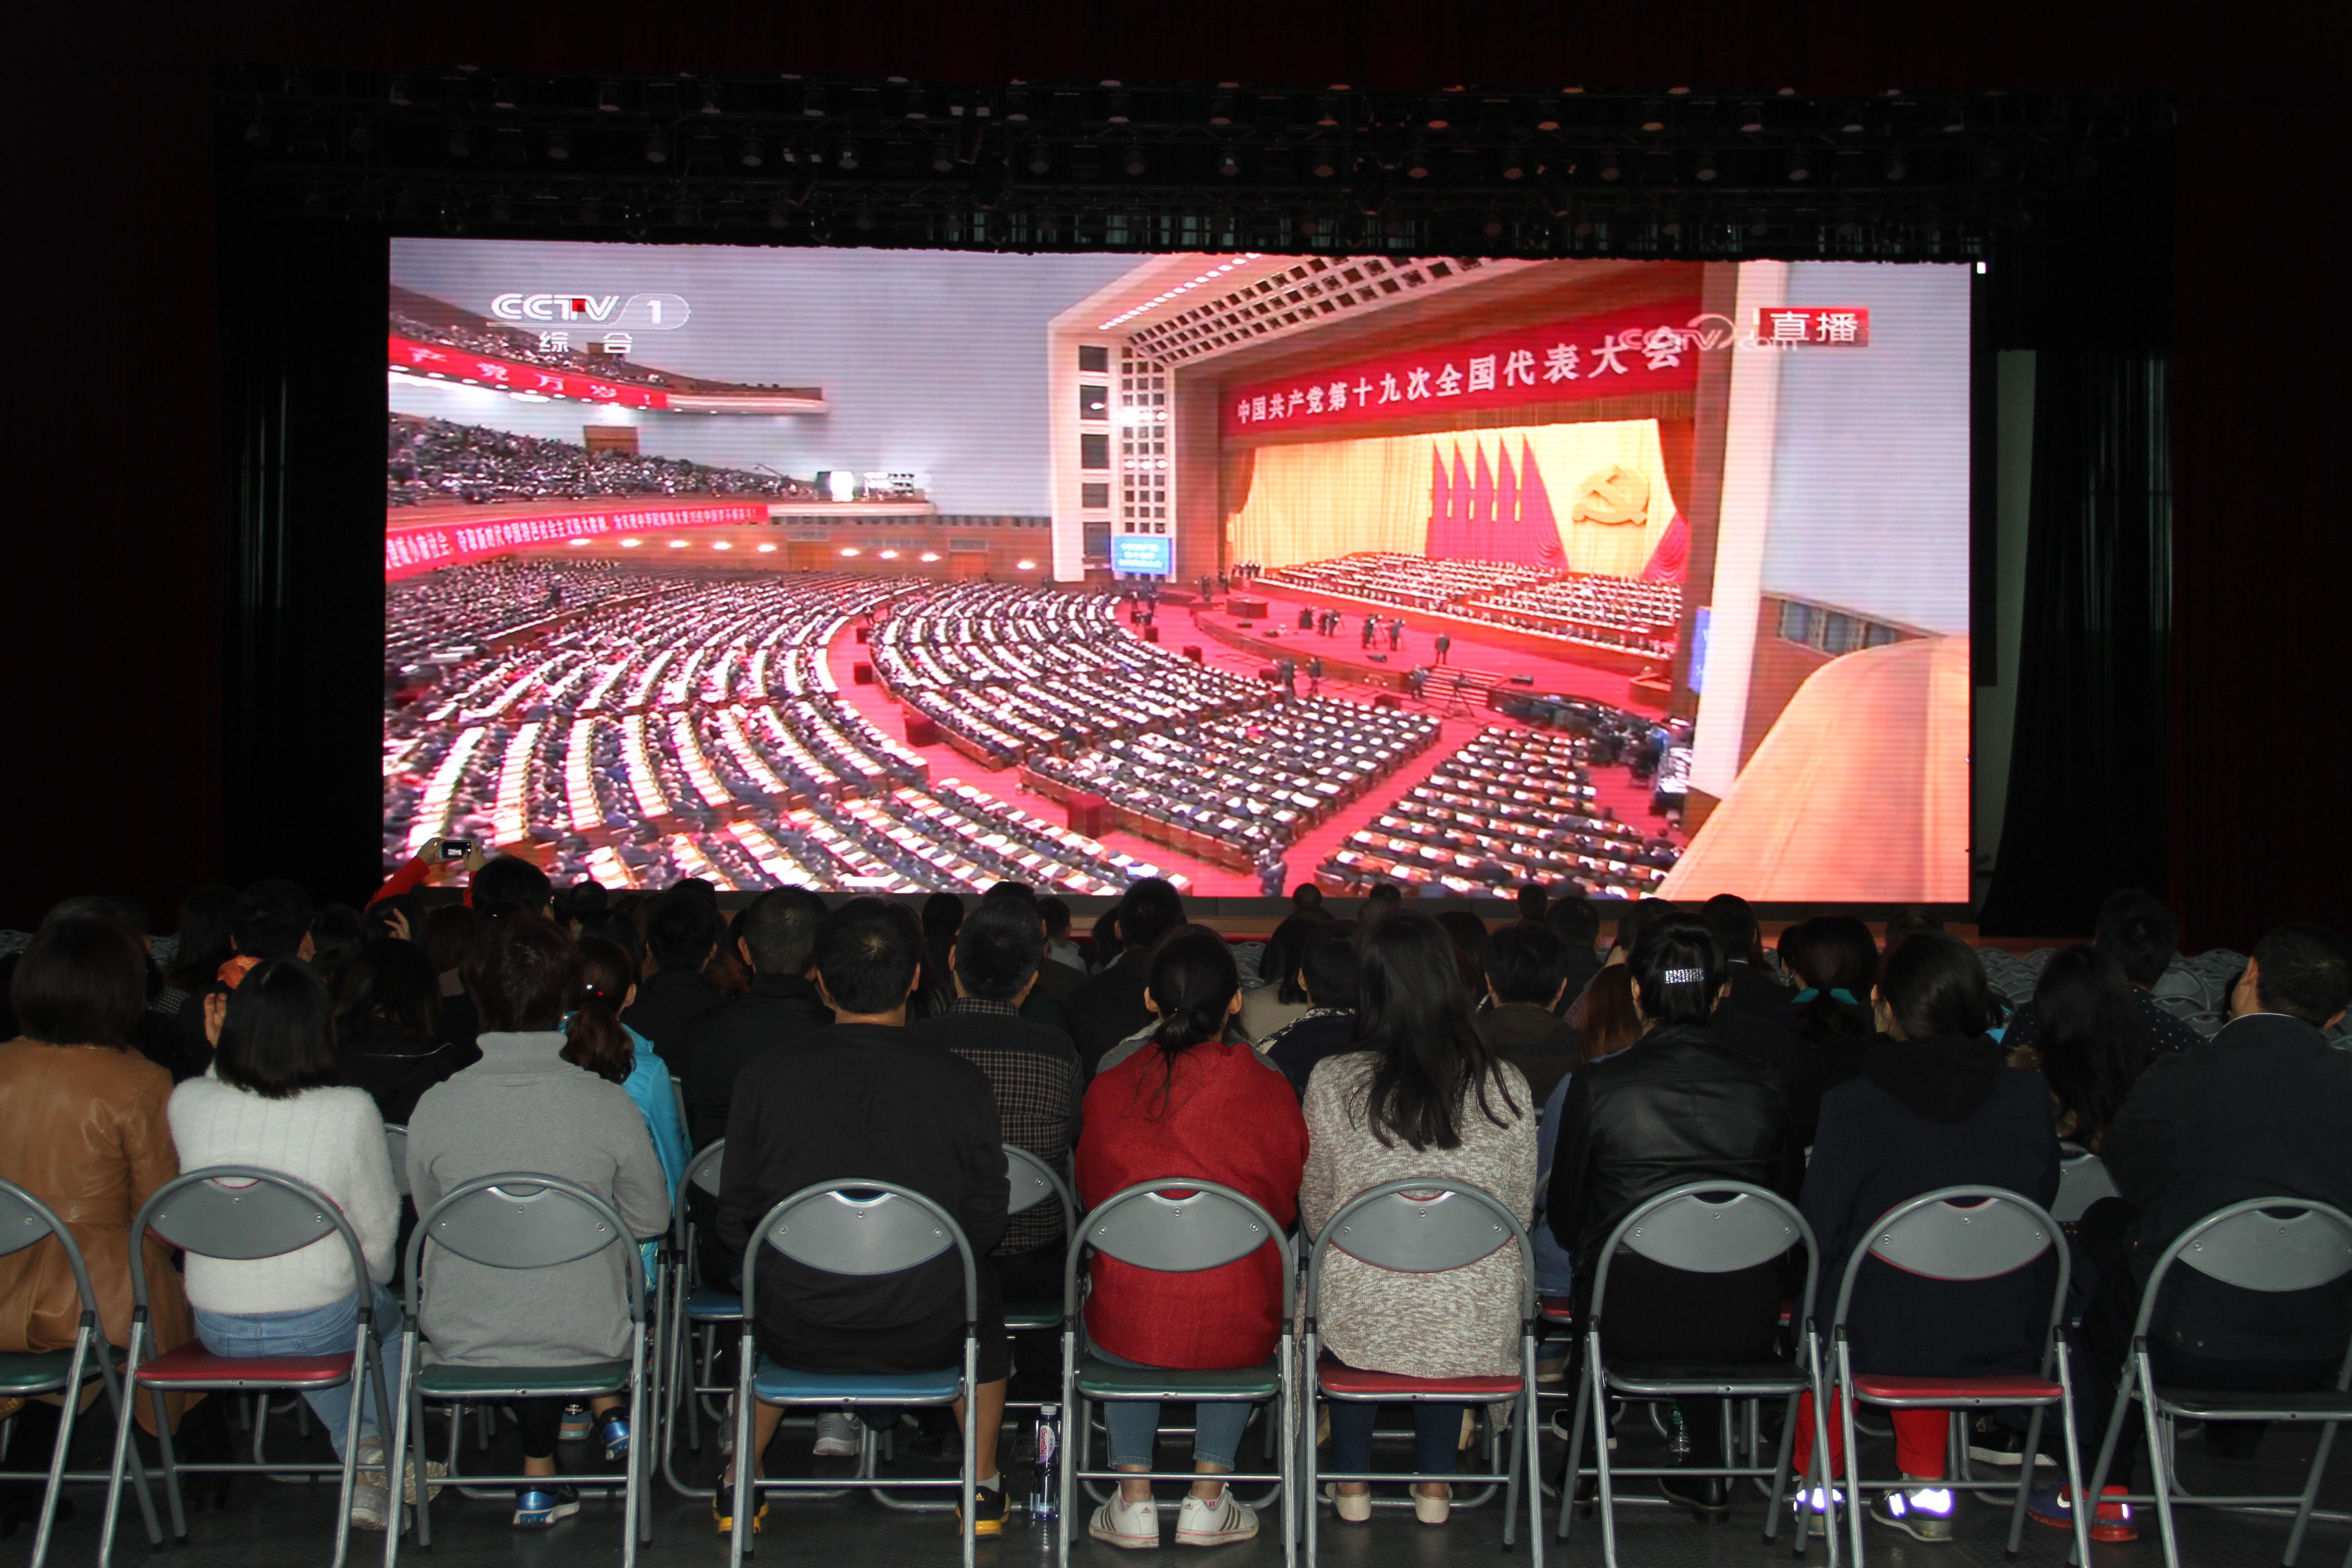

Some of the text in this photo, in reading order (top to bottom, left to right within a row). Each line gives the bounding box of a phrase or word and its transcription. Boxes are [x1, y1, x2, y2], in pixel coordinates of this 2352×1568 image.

[491, 293, 662, 324] CCTV 1
[539, 332, 632, 353] 综合
[1770, 311, 1858, 343] 直播
[1237, 326, 1682, 425] 中国共产党第十九次全国代表大会
